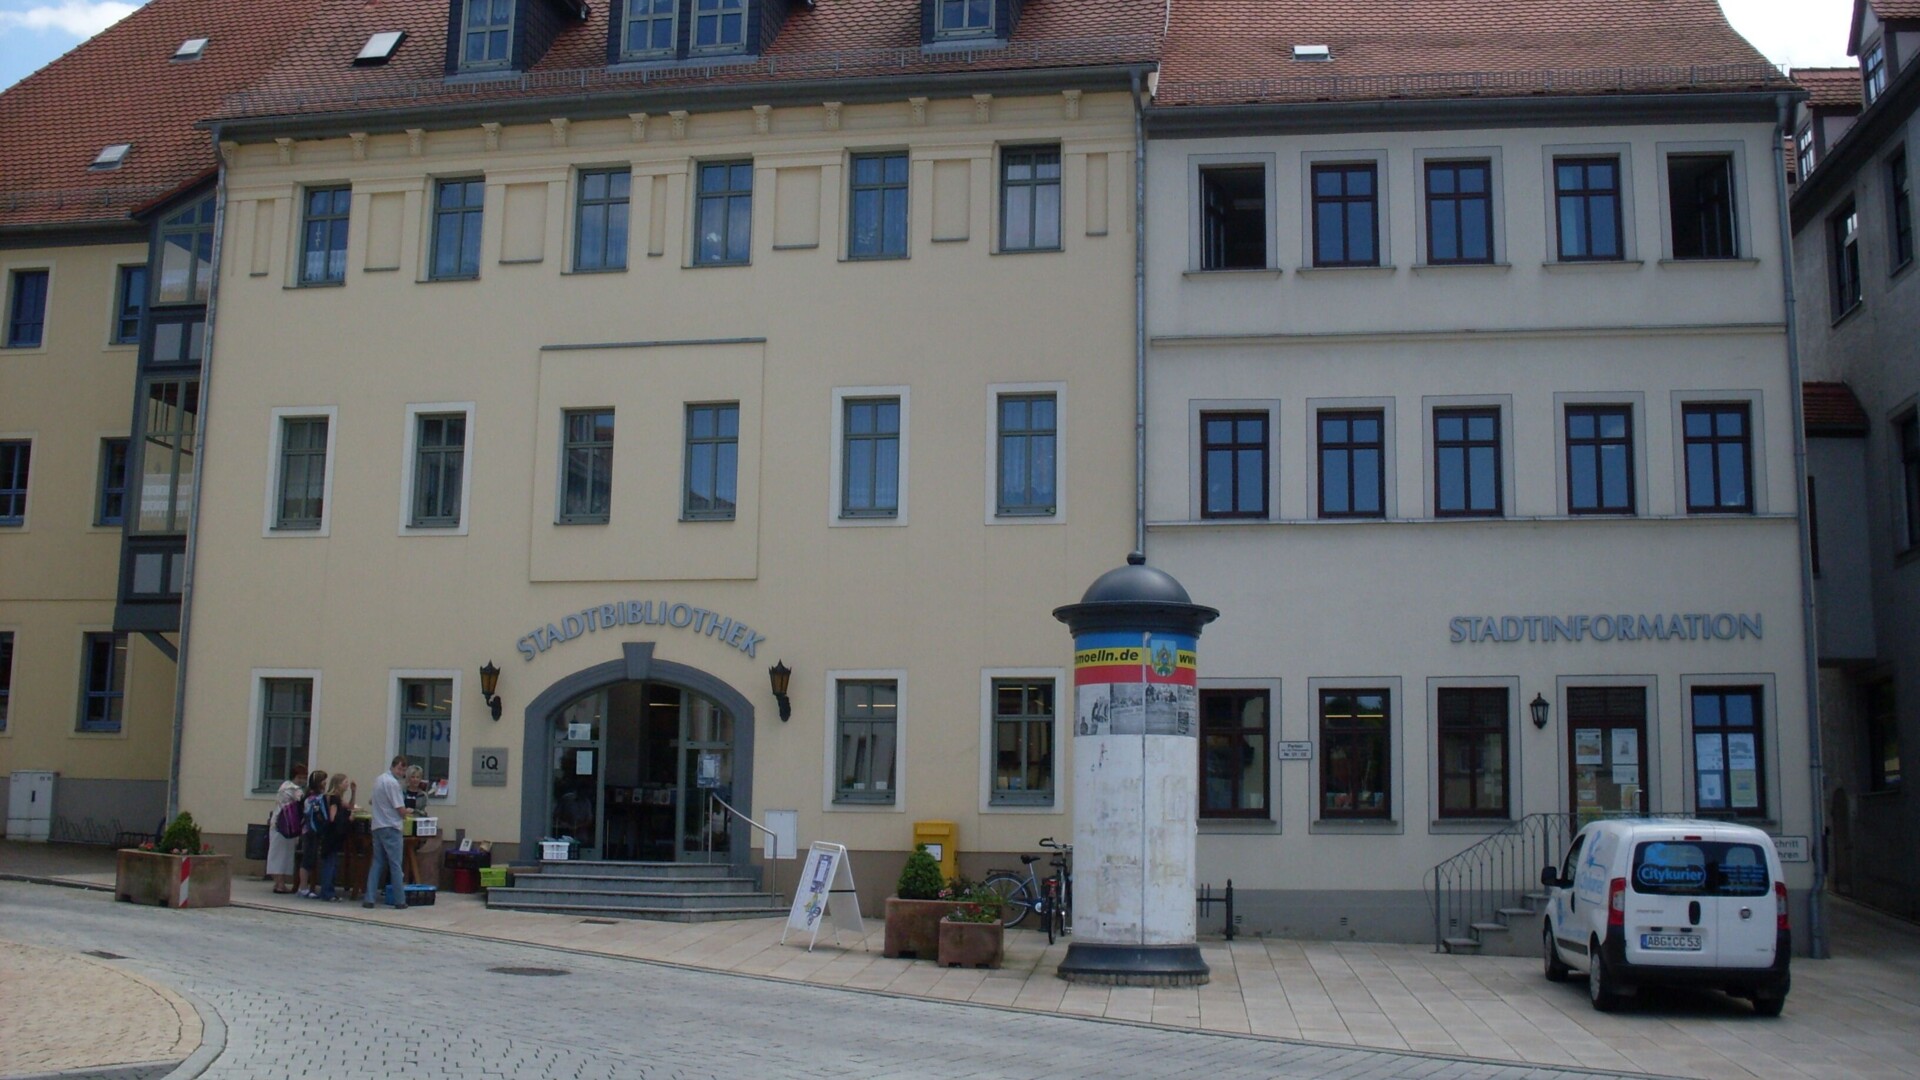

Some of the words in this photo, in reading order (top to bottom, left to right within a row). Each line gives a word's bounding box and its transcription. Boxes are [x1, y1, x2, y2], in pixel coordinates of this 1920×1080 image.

[516, 600, 766, 662] STADTBIBLIOTHEK
[1450, 613, 1763, 643] STADTINFORMATION
[481, 755, 498, 771] iQ
[1774, 840, 1799, 848] chritt
[1778, 851, 1800, 859] hren
[1641, 867, 1703, 883] Citykurier
